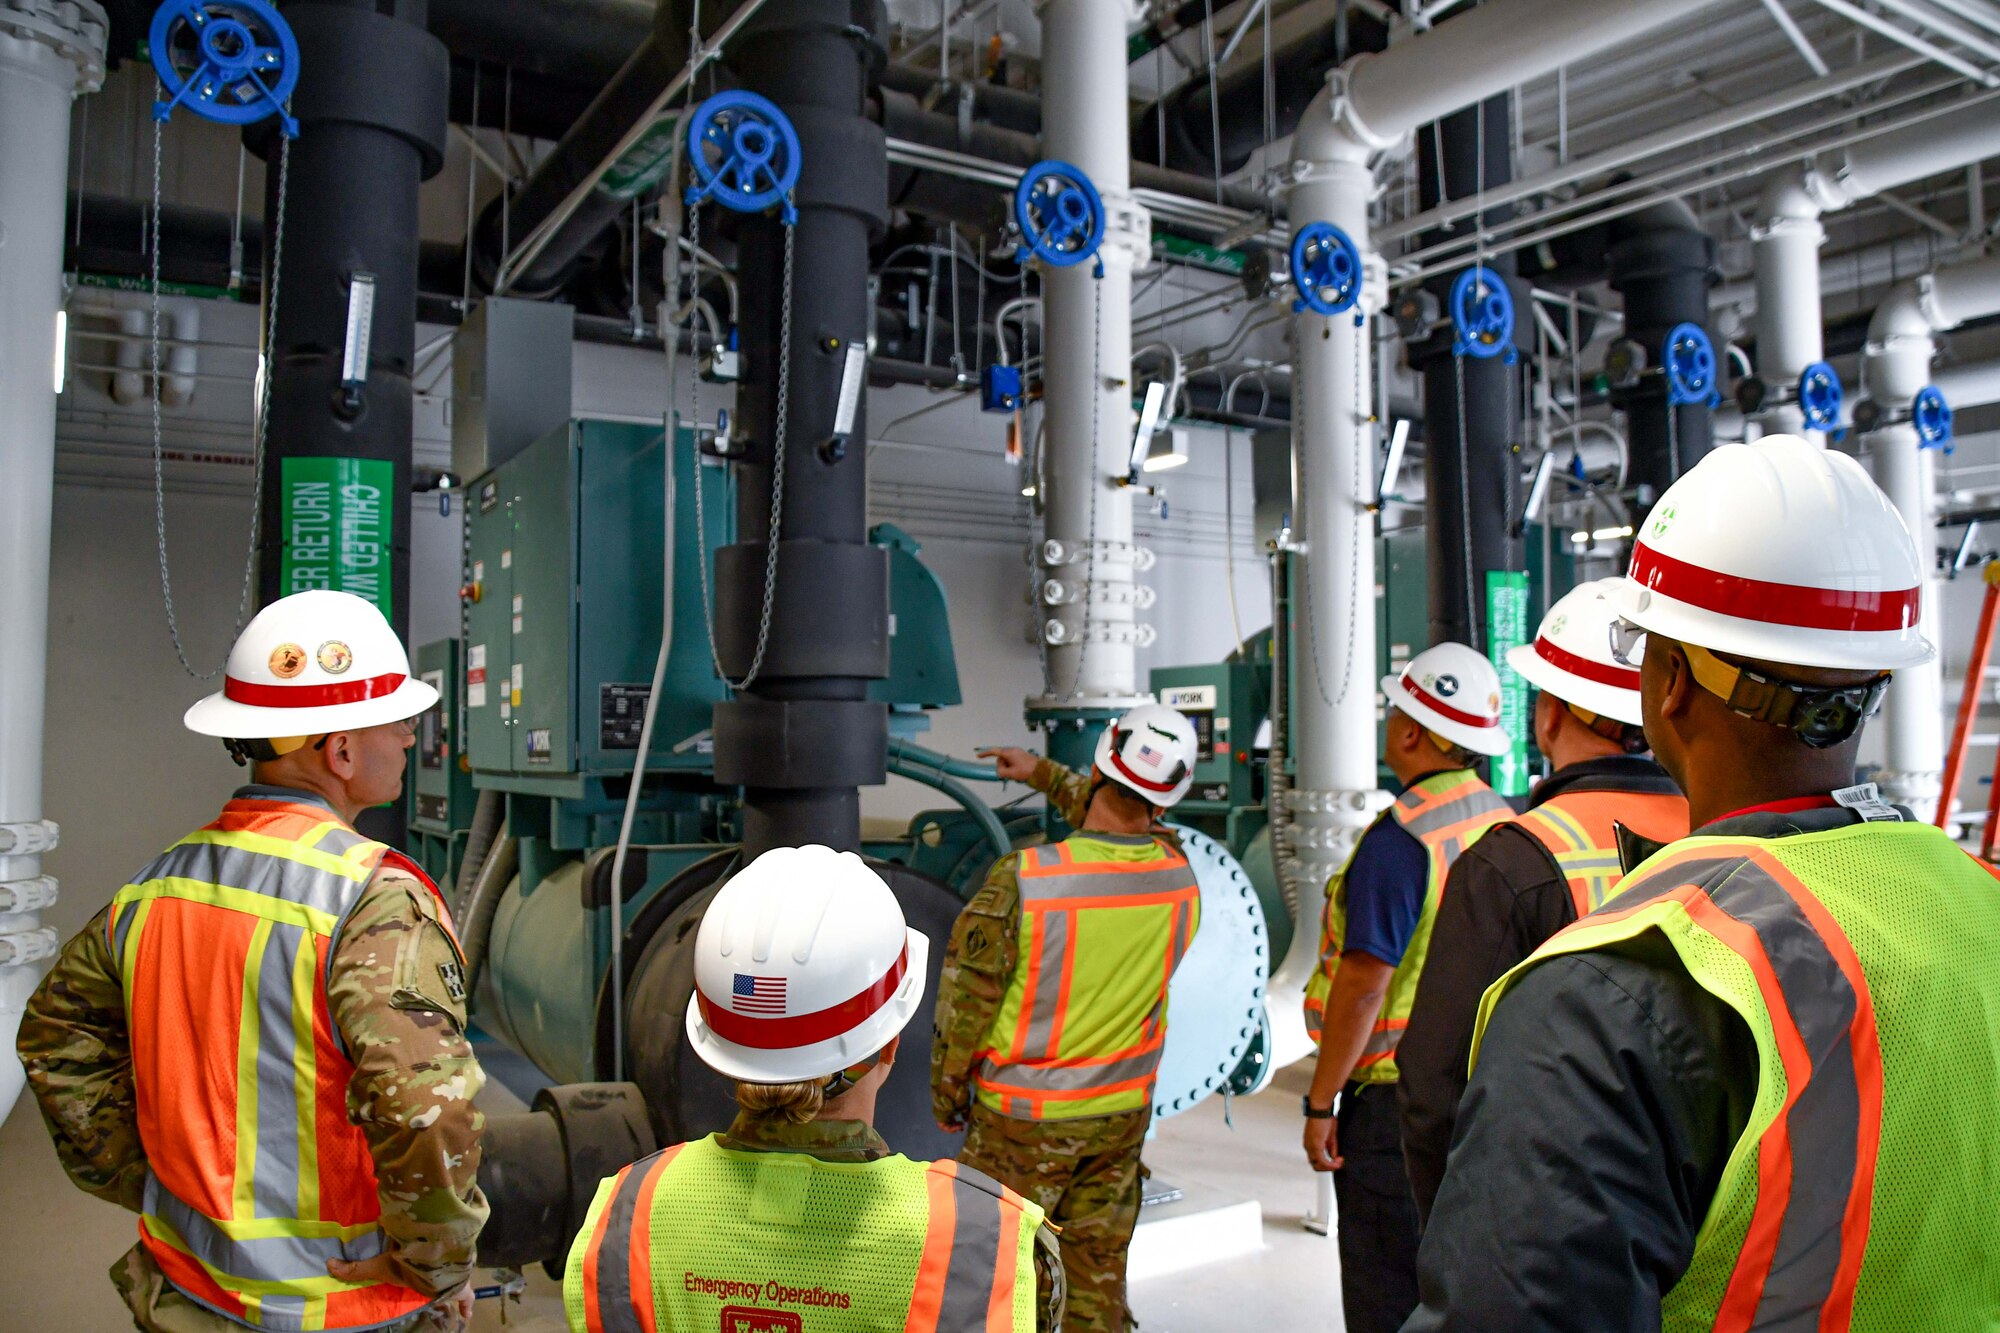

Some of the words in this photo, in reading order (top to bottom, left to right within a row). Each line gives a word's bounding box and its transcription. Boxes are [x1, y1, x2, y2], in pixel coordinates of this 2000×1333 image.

[292, 482, 331, 560] RETURN
[340, 484, 381, 568] CHILLED
[1177, 691, 1203, 704] YORK
[684, 1271, 763, 1305] Emergency
[766, 1279, 851, 1310] Operations
